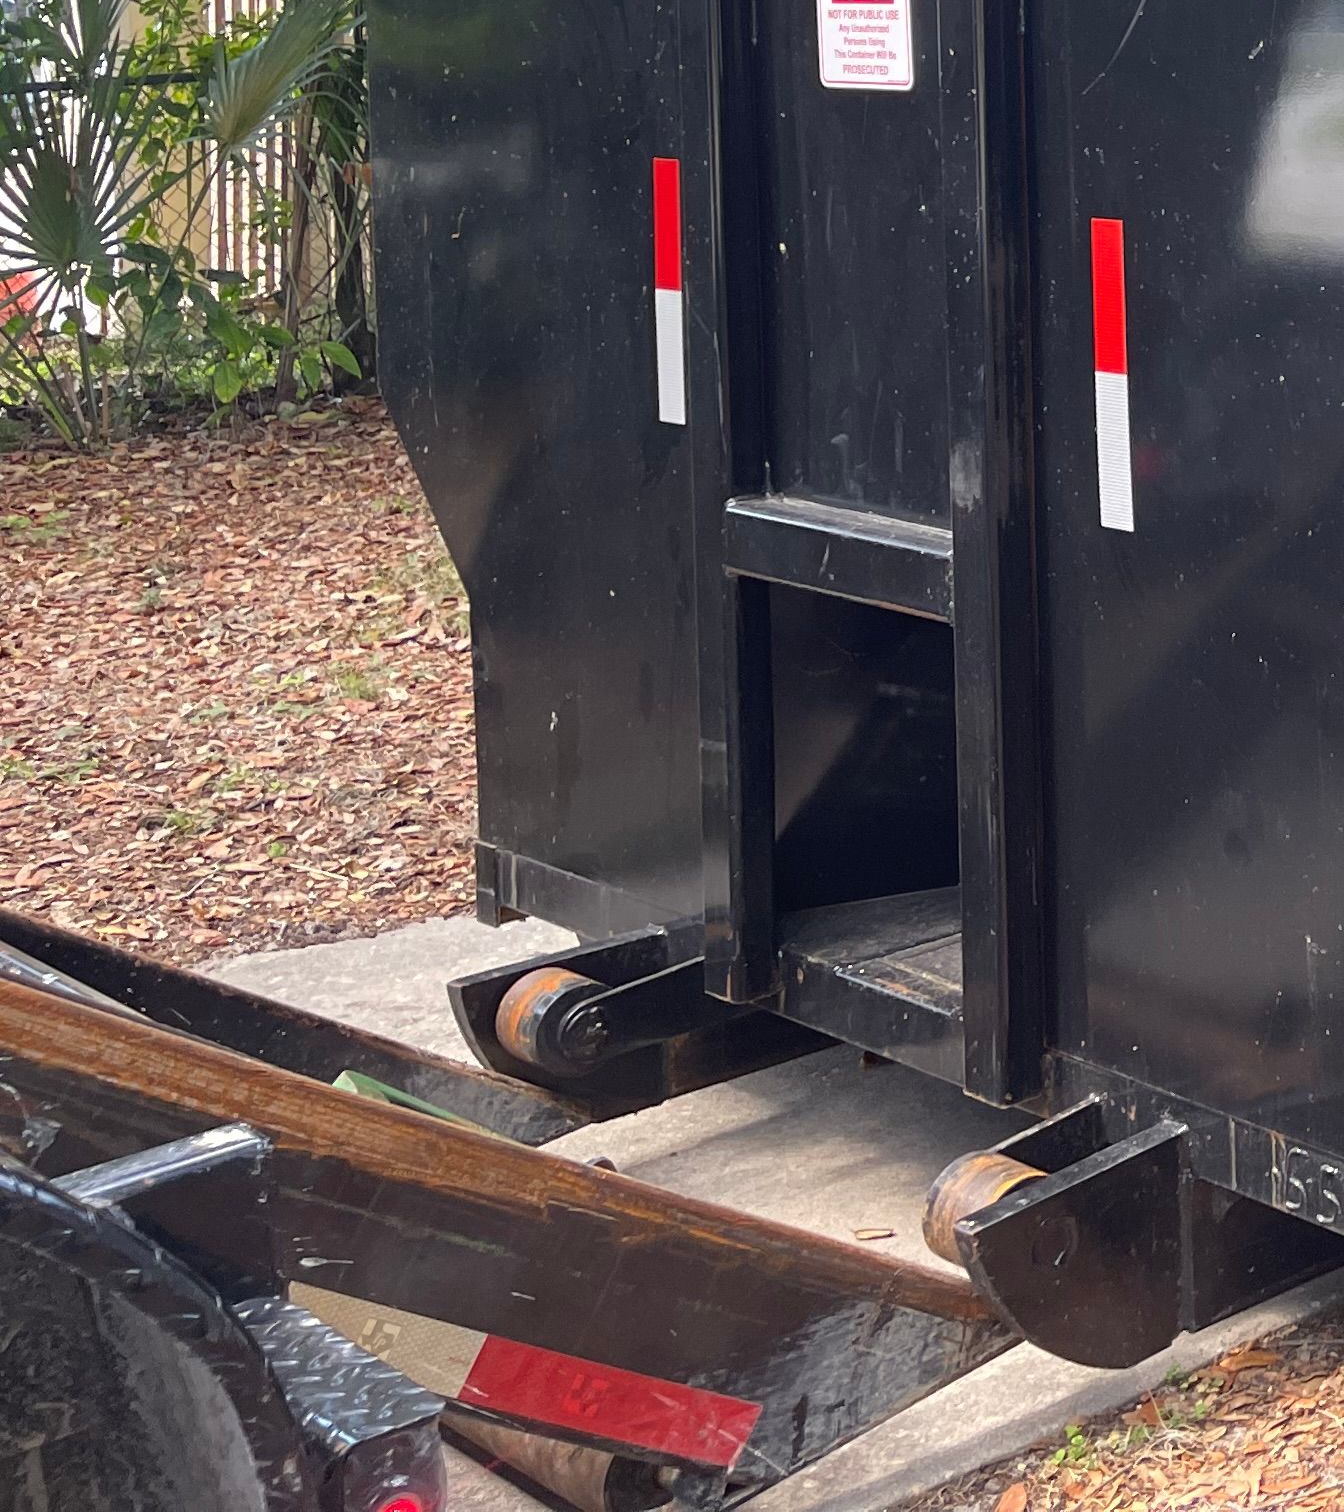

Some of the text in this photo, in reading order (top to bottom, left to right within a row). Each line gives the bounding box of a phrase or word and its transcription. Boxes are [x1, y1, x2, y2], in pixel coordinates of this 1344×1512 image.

[828, 10, 898, 20] NOT FOR PUBLIC USE
[843, 65, 888, 75] PROSECUTED
